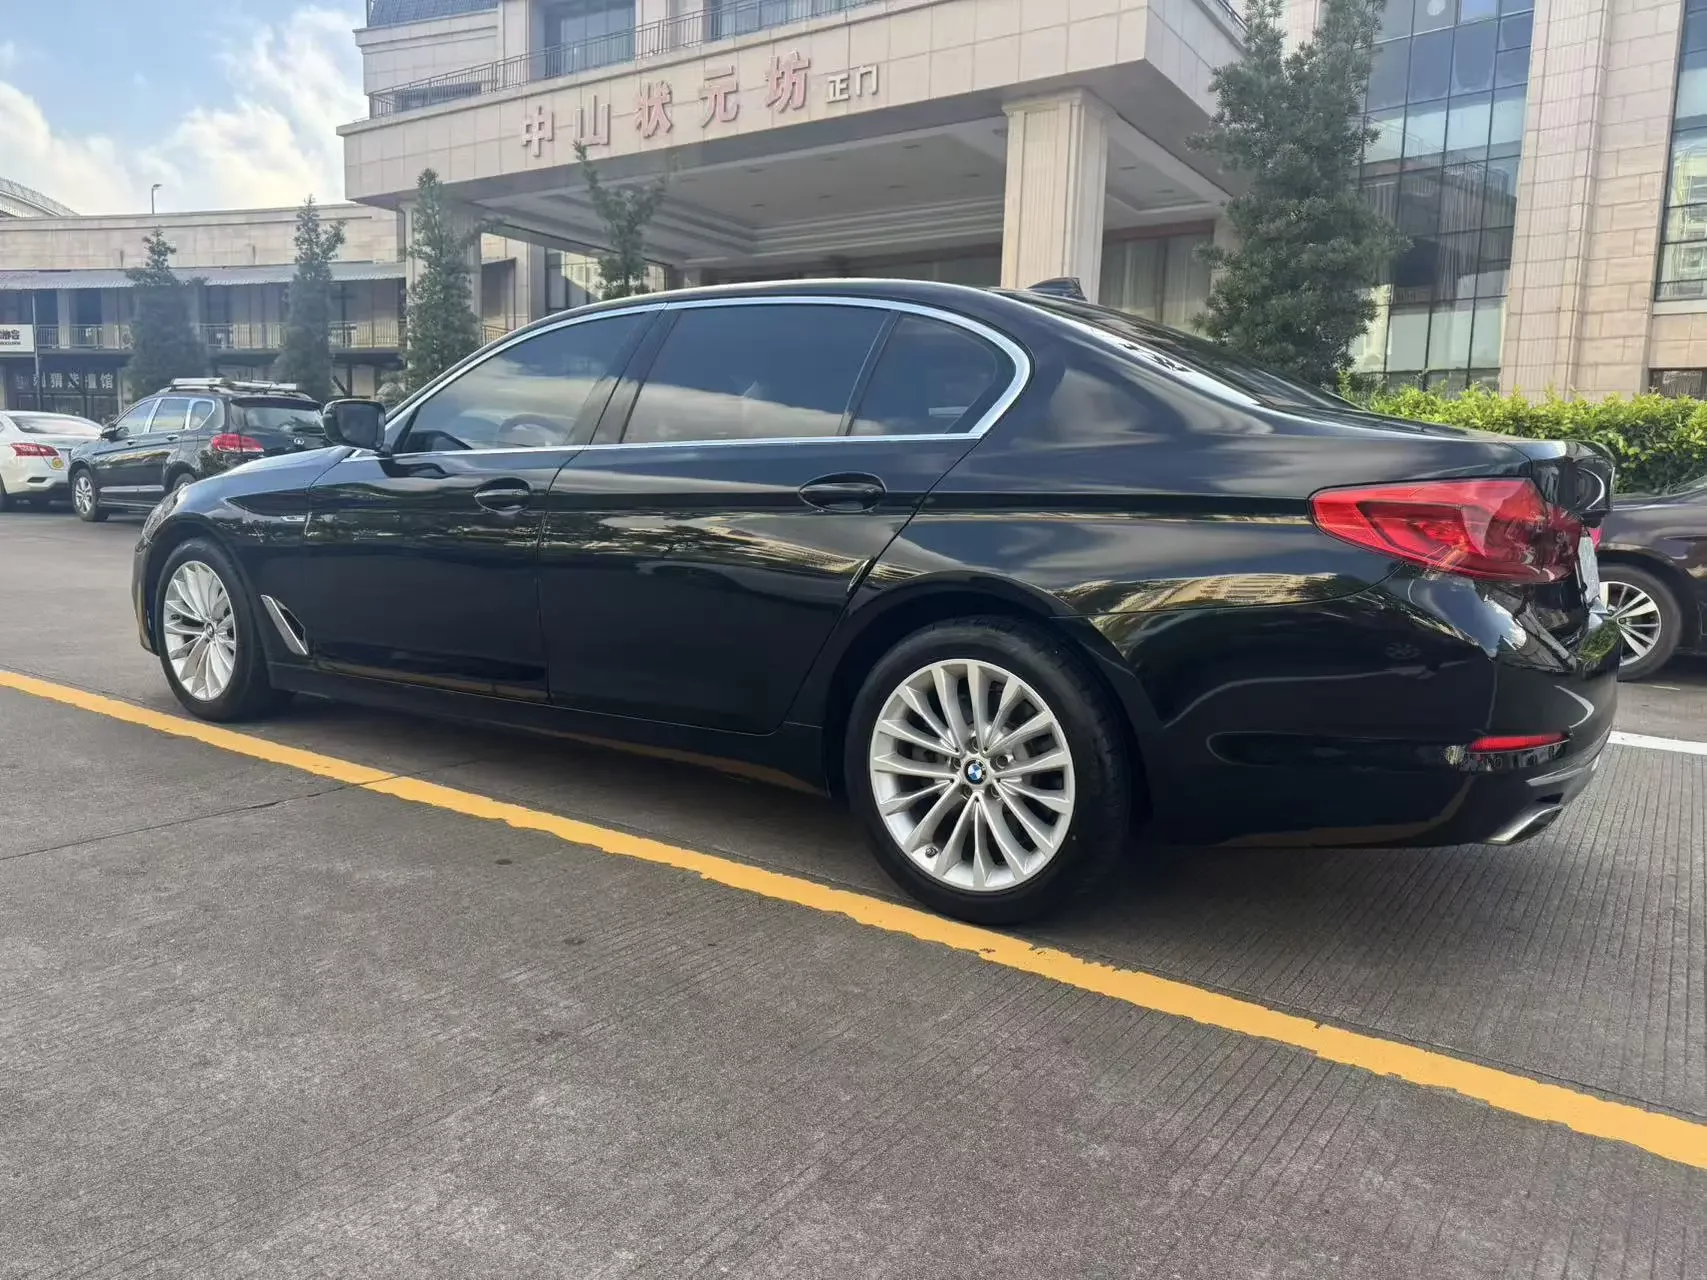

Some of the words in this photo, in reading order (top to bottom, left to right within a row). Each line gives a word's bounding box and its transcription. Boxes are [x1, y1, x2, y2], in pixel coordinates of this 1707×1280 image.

[520, 50, 812, 158] 中山状元坊
[826, 63, 879, 103] 正门
